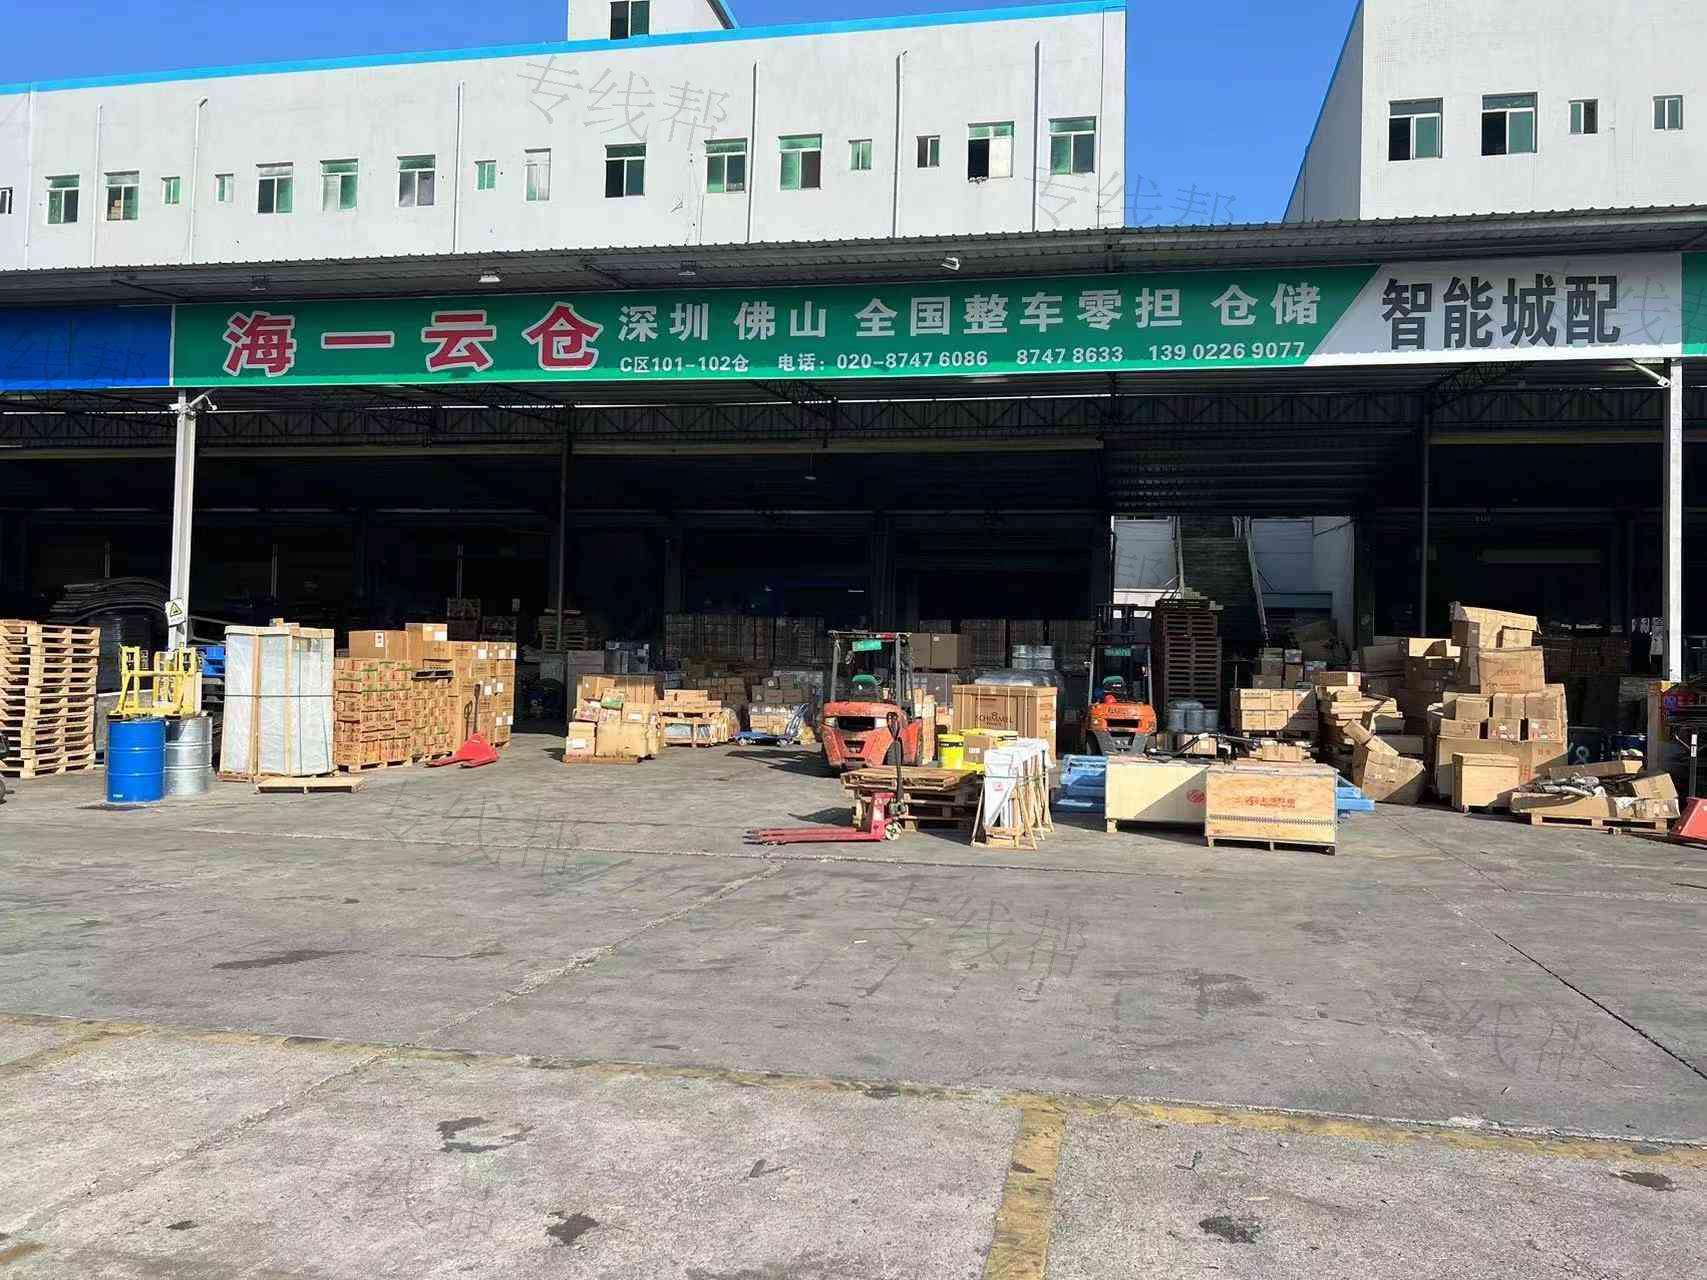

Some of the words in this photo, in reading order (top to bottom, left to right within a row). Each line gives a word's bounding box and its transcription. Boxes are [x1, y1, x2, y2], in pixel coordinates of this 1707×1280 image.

[617, 302, 709, 342] 深圳
[733, 301, 827, 341] 佛山
[855, 287, 1183, 337] 全国整车零担
[1211, 282, 1321, 327] 仓储
[1381, 273, 1621, 350] 智能城配
[222, 301, 604, 377] 海一云仓
[1016, 348, 1065, 365] 8747
[1072, 346, 1124, 363] 8633
[1149, 344, 1187, 362] 139
[1192, 342, 1246, 360] 0226
[1251, 341, 1306, 359] 9077
[619, 353, 749, 373] C区101-102仓
